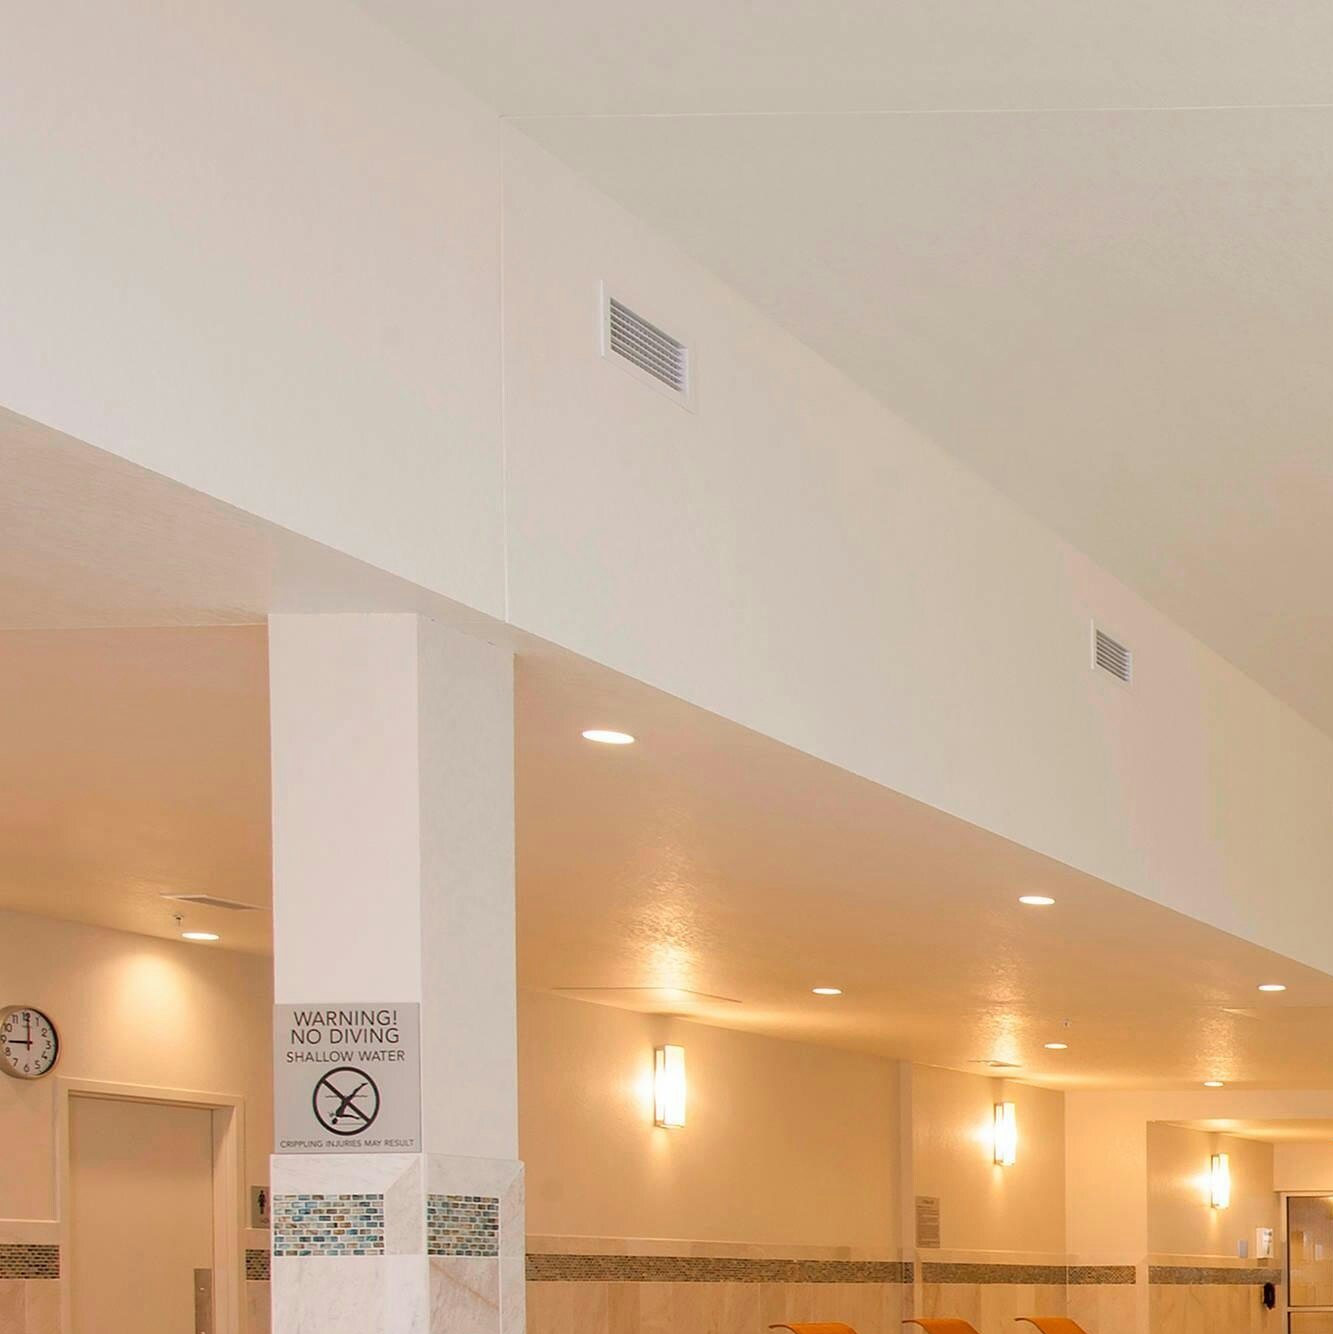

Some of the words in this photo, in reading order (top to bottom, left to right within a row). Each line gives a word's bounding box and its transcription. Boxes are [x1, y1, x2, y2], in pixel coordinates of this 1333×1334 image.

[11, 1014, 19, 1024] 11
[35, 1016, 40, 1027] 1
[294, 1010, 397, 1027] WARNING!
[41, 1028, 48, 1038] 2
[291, 1029, 322, 1044] NO
[330, 1028, 400, 1044] DIVING
[45, 1040, 52, 1050] 3
[5, 1046, 11, 1057] 8
[41, 1051, 48, 1060] 4
[286, 1051, 354, 1063] SHALLOW
[358, 1050, 405, 1062] WATER
[12, 1057, 19, 1066] 7
[34, 1060, 41, 1070] 5
[24, 1064, 30, 1072] 6
[280, 1140, 323, 1149] CRIPPLING
[325, 1140, 362, 1148] INJURIES
[364, 1139, 382, 1147] MAY
[384, 1139, 414, 1147] RESULT
